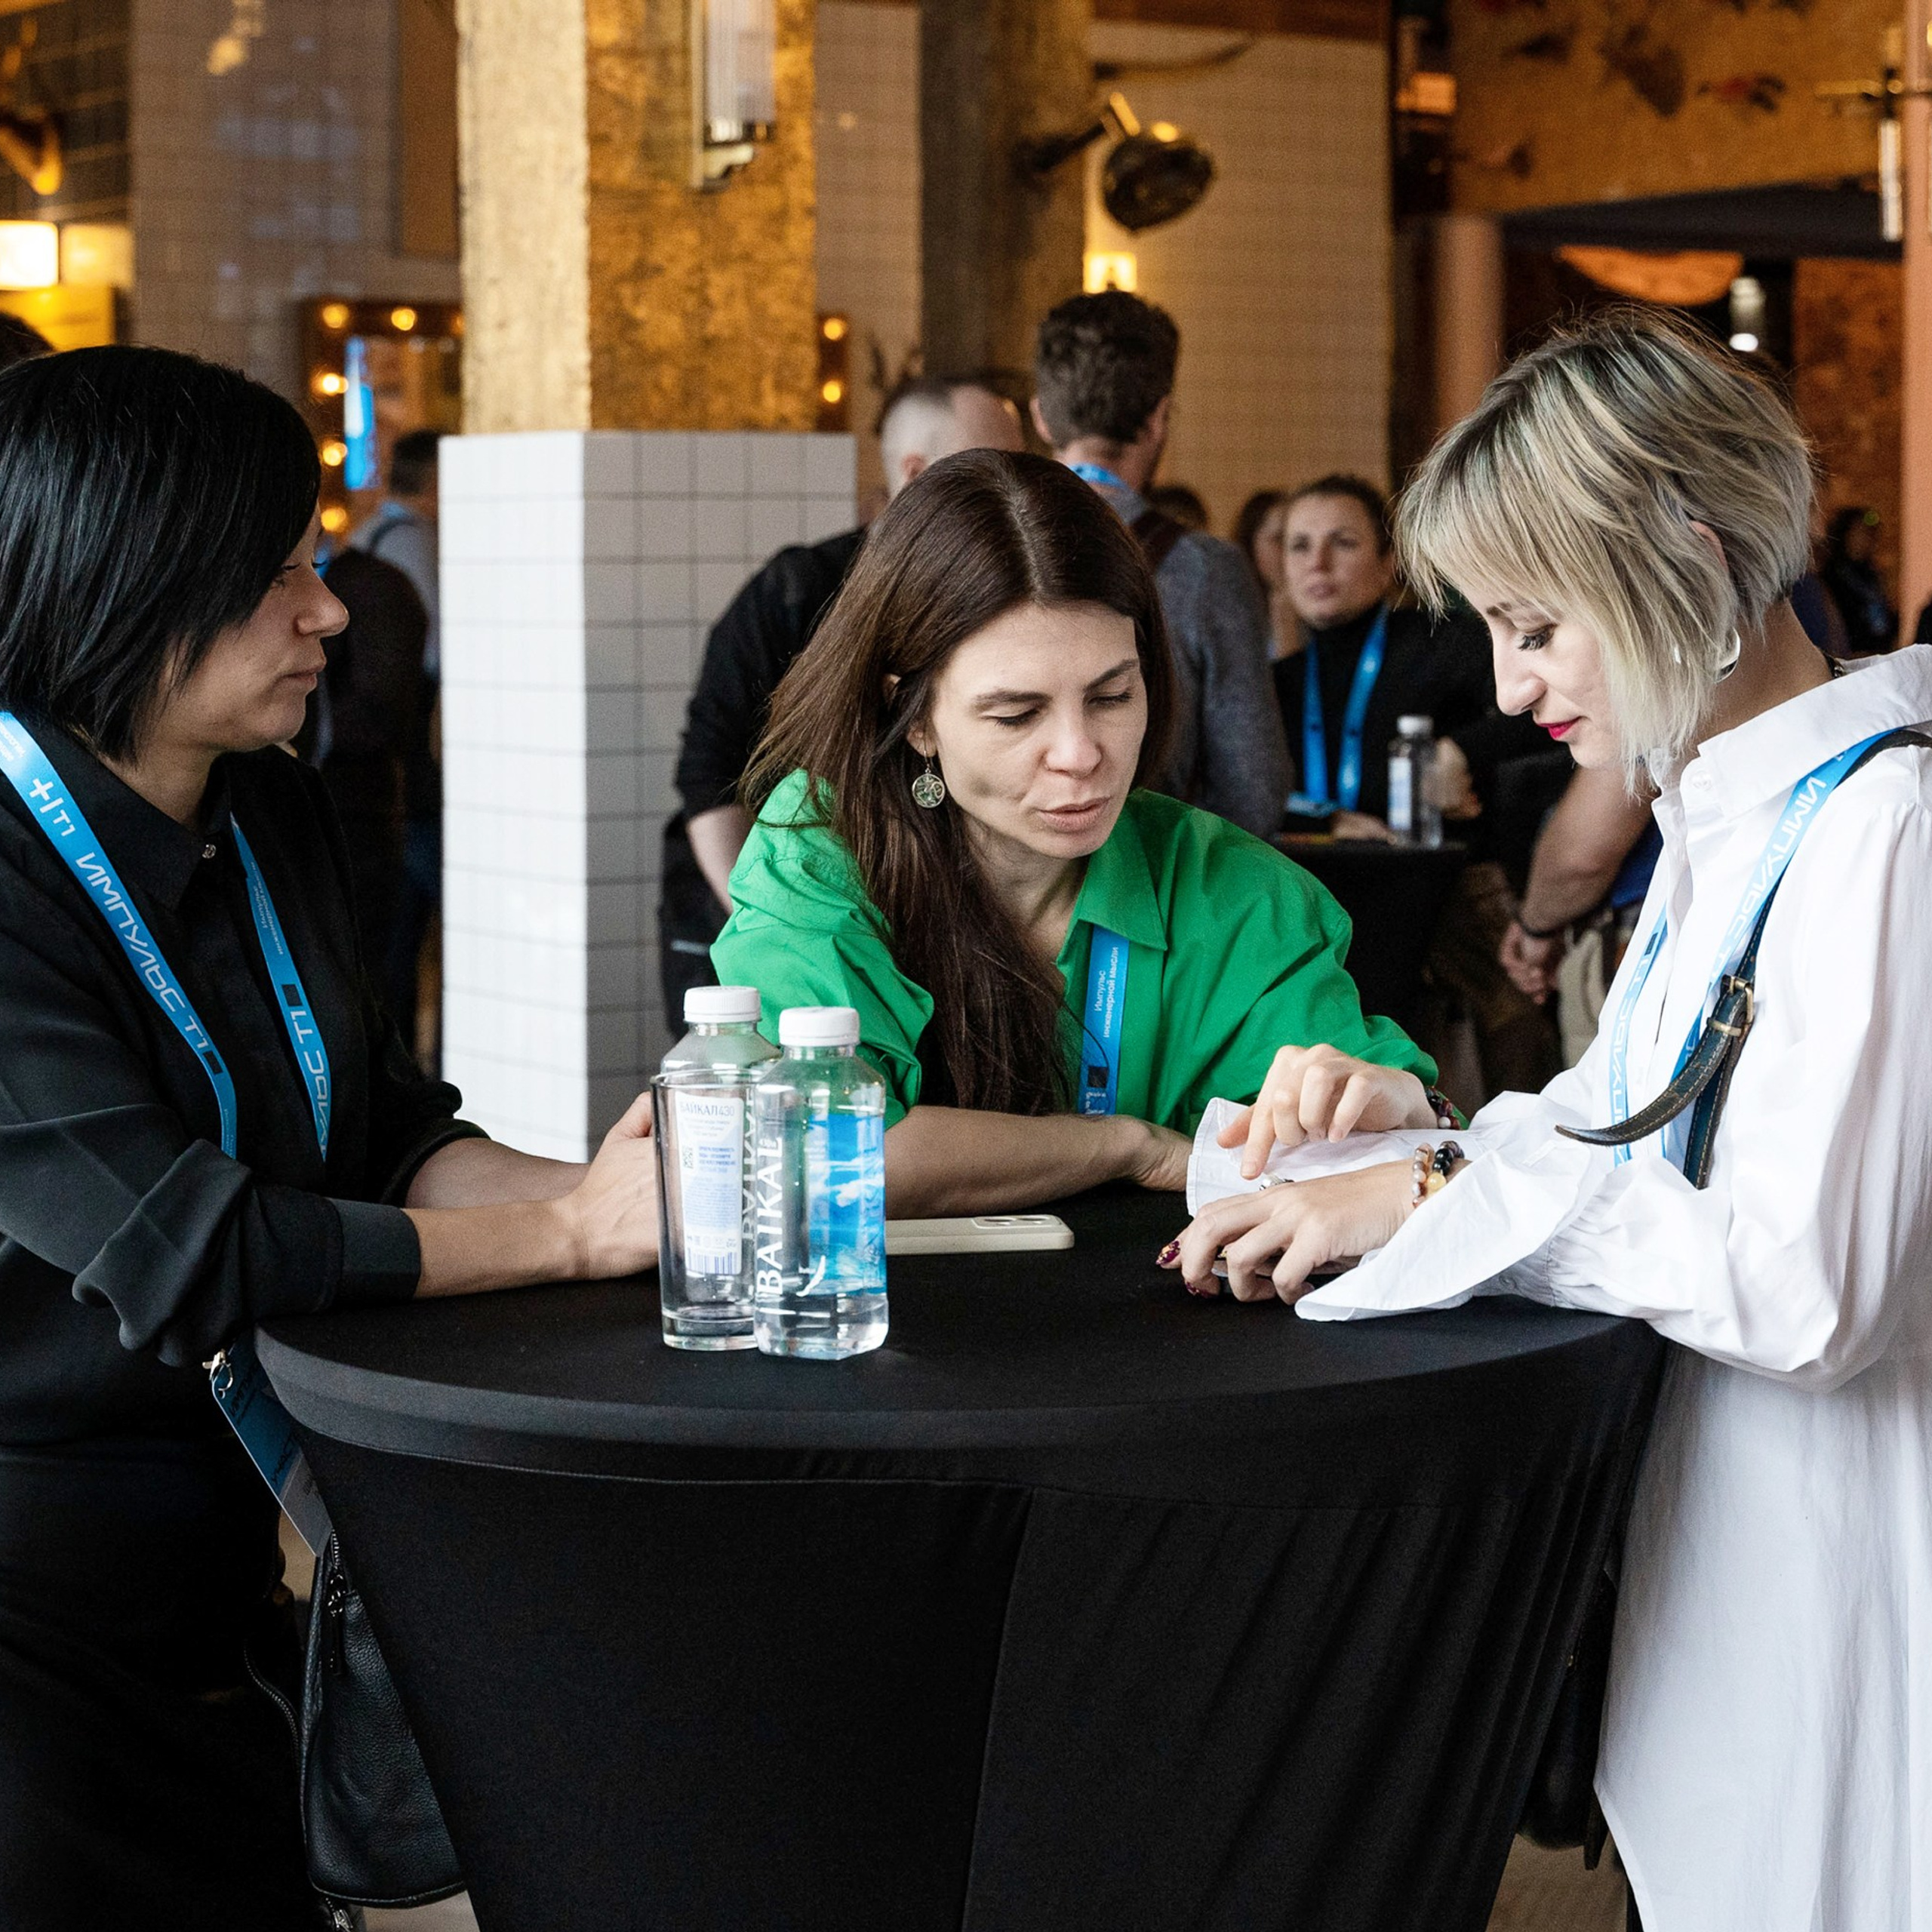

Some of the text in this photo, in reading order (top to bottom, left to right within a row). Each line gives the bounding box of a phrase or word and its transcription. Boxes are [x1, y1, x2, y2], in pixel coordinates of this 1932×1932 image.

[75, 852, 210, 1049] ИМПУЛЬС Т1
[1094, 970, 1106, 1011] Импульс
[1103, 947, 1118, 1038] инженерной мысли
[291, 1011, 313, 1044] Т1
[756, 1137, 783, 1294] BAIKAL
